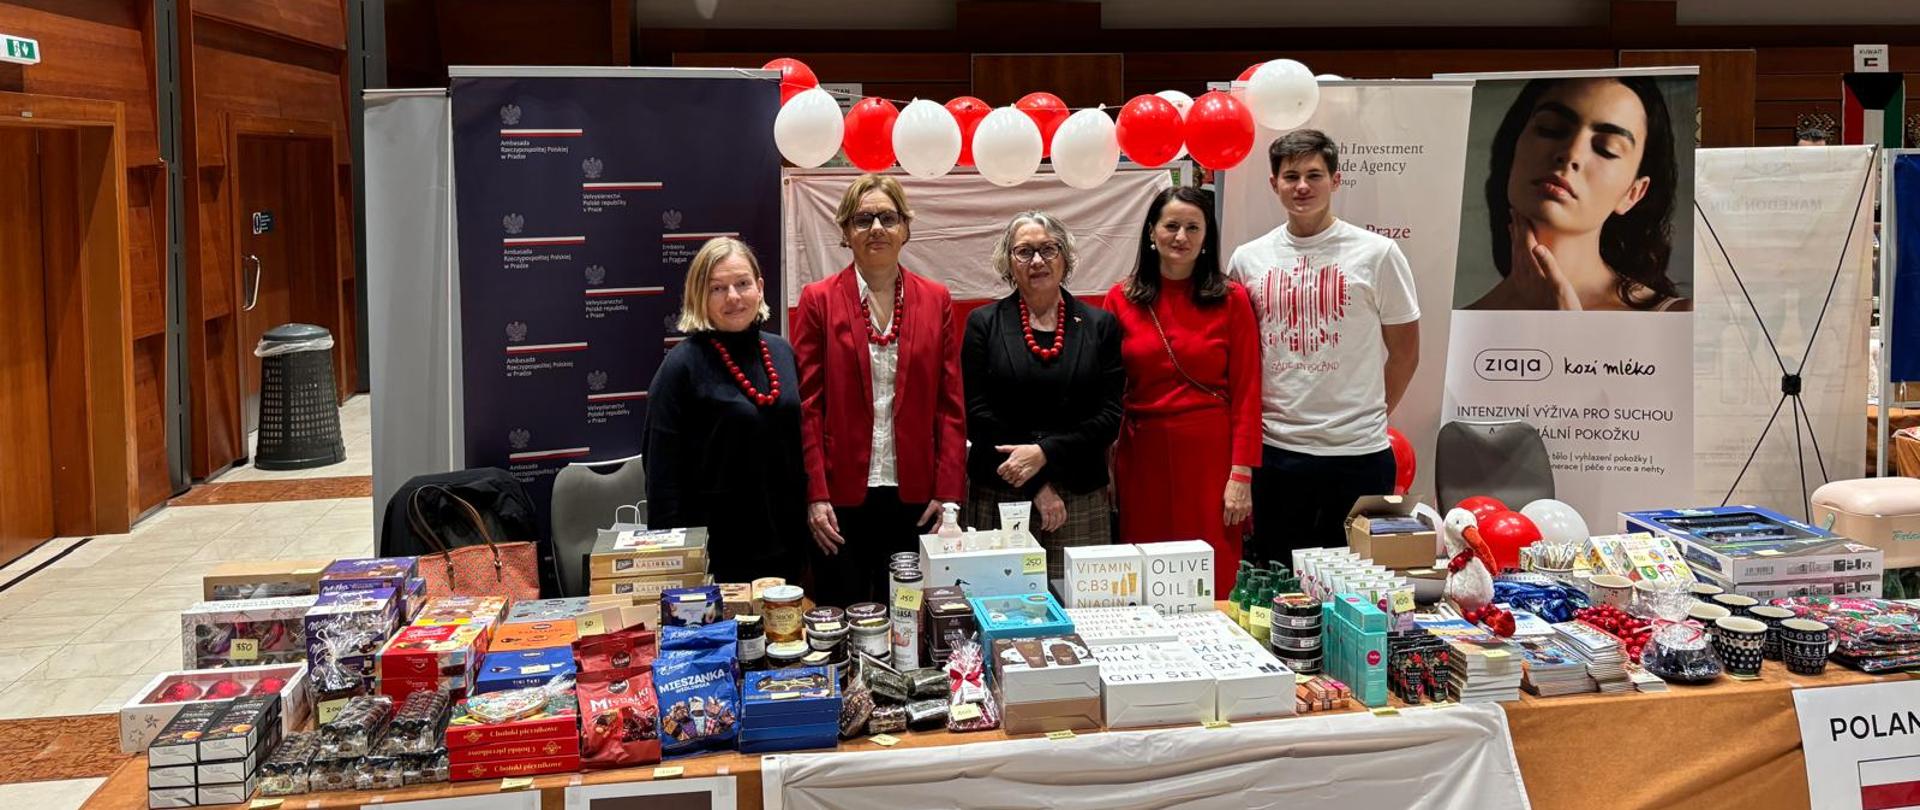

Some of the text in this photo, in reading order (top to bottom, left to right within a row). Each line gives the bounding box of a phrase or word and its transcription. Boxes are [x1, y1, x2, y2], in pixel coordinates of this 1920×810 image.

[1352, 143, 1424, 154] Investment
[1338, 159, 1406, 175] ade Agency
[1340, 178, 1357, 188] oup
[552, 361, 574, 369] Polskiej
[1485, 357, 1656, 377] ziaja kozi mléko
[1457, 404, 1674, 421] INTENZIVNÍ VÝŽIVA PRO SUCHOU
[1537, 425, 1570, 440] ÁLNÍ
[1575, 427, 1640, 440] POKOŽKU
[1552, 452, 1648, 464] tělo vyhlazení pokožky
[1584, 462, 1604, 473] péče
[1641, 465, 1665, 475] nehty
[1077, 561, 1132, 574] VITAMIN
[1152, 558, 1209, 574] OLIVE
[1152, 581, 1184, 597] OIL
[1153, 603, 1197, 617] GIFT
[1192, 643, 1243, 654] MEN
[1096, 654, 1145, 663] MILK
[1201, 651, 1255, 662] GIFT
[1210, 661, 1253, 671] SET
[658, 667, 726, 695] MIESZANKA
[1109, 671, 1202, 682] GIFT SET
[1830, 710, 1920, 742] POLAN
